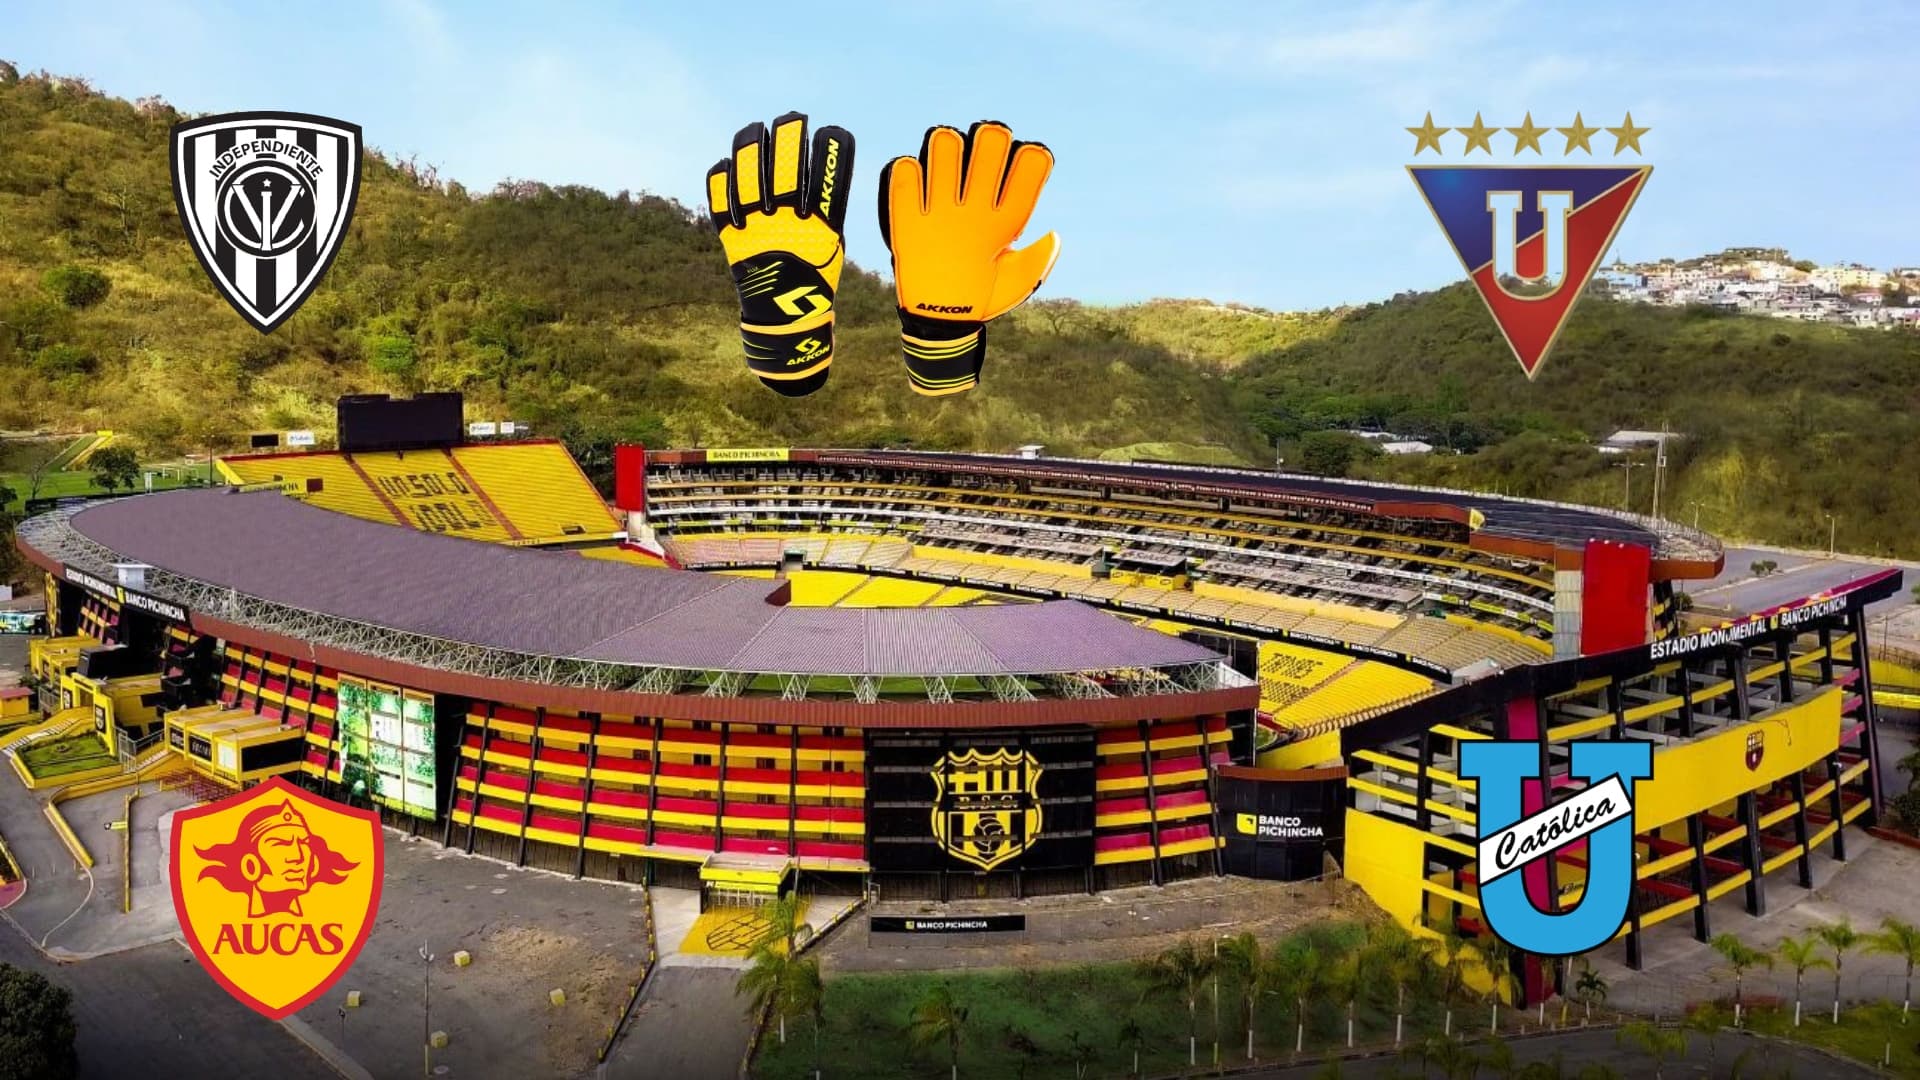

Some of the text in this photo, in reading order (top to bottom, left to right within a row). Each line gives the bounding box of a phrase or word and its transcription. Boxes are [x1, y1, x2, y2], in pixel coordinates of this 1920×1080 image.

[1781, 596, 1847, 627] BANCO PICHINCHA
[1650, 618, 1767, 660] ESTADIO MONUMENTAL
[1258, 815, 1302, 827] BANCO
[1258, 826, 1324, 838] PICHINCHA
[916, 920, 988, 930] BANCO PICHINCHA
